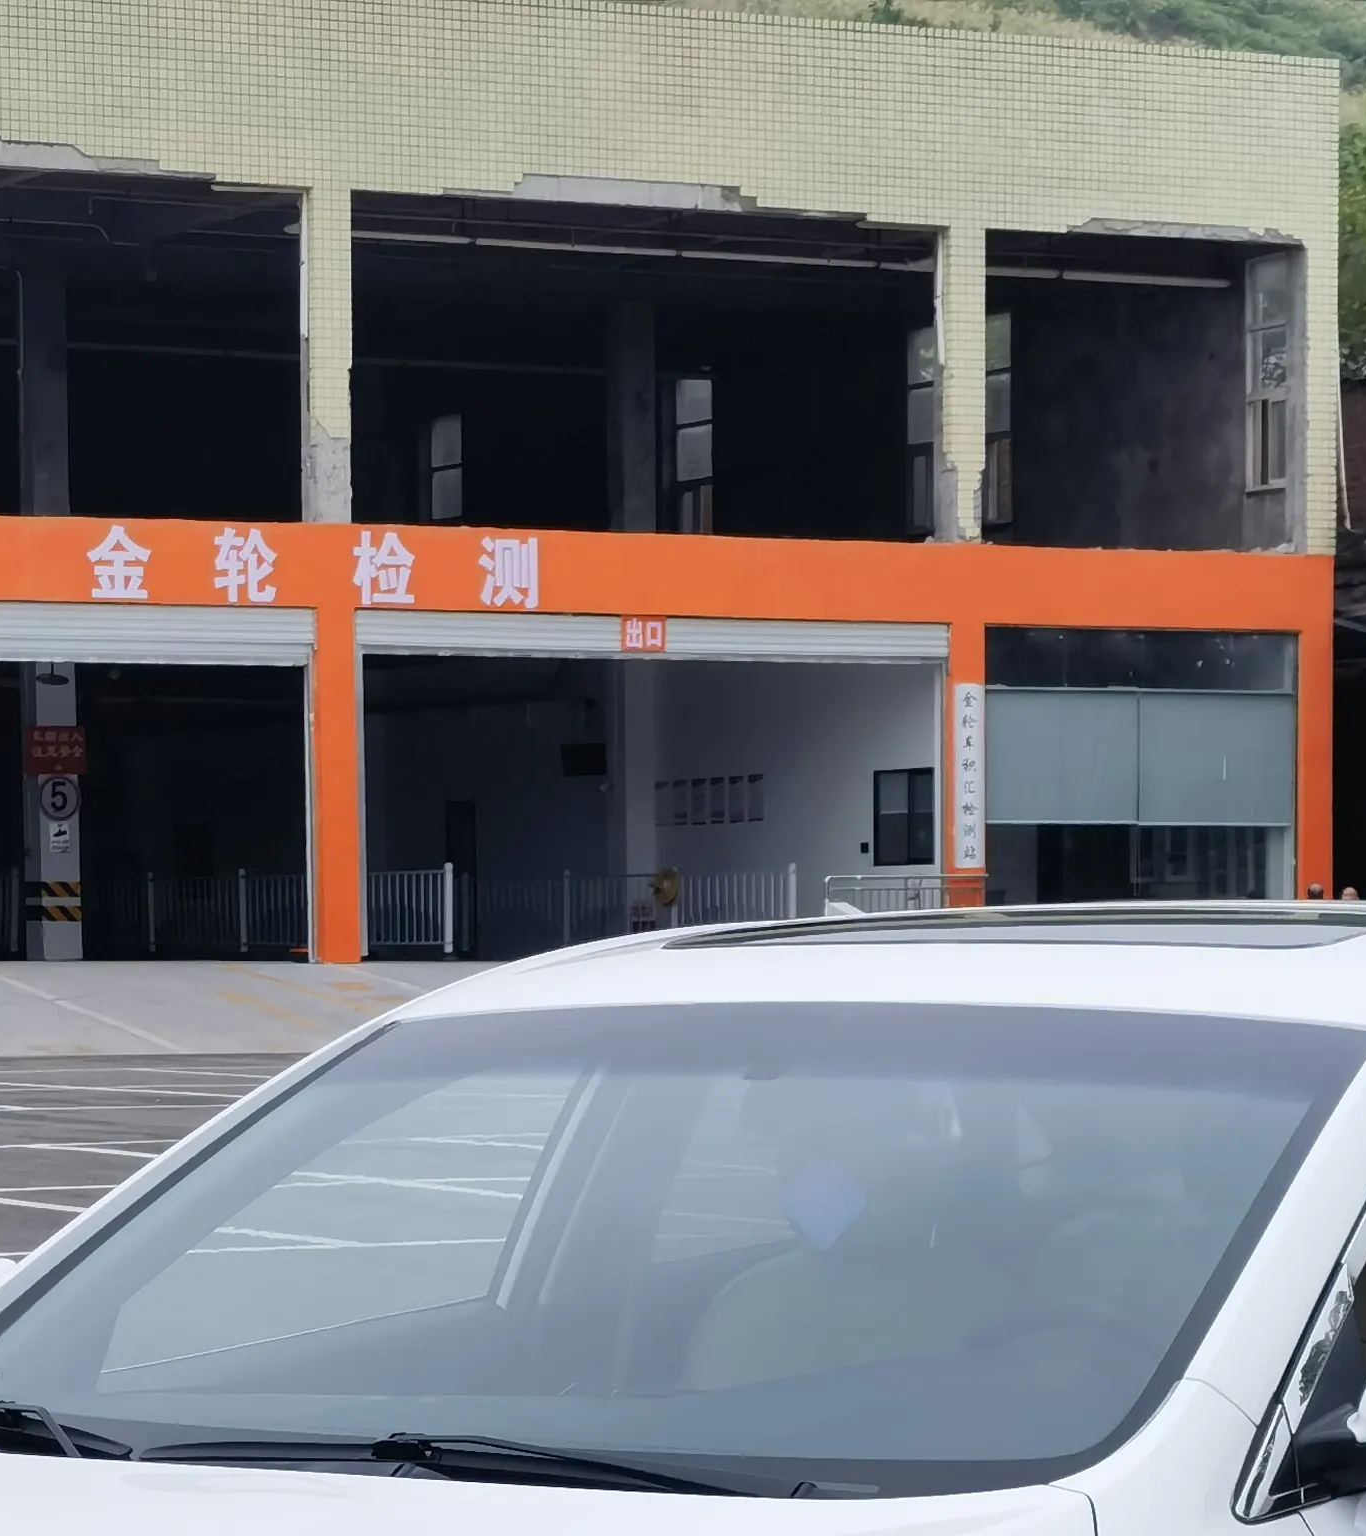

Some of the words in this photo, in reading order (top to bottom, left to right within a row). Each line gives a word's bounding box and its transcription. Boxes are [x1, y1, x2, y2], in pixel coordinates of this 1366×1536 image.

[87, 525, 539, 609] 金轮检测
[626, 617, 662, 649] 出口
[51, 781, 68, 811] 5
